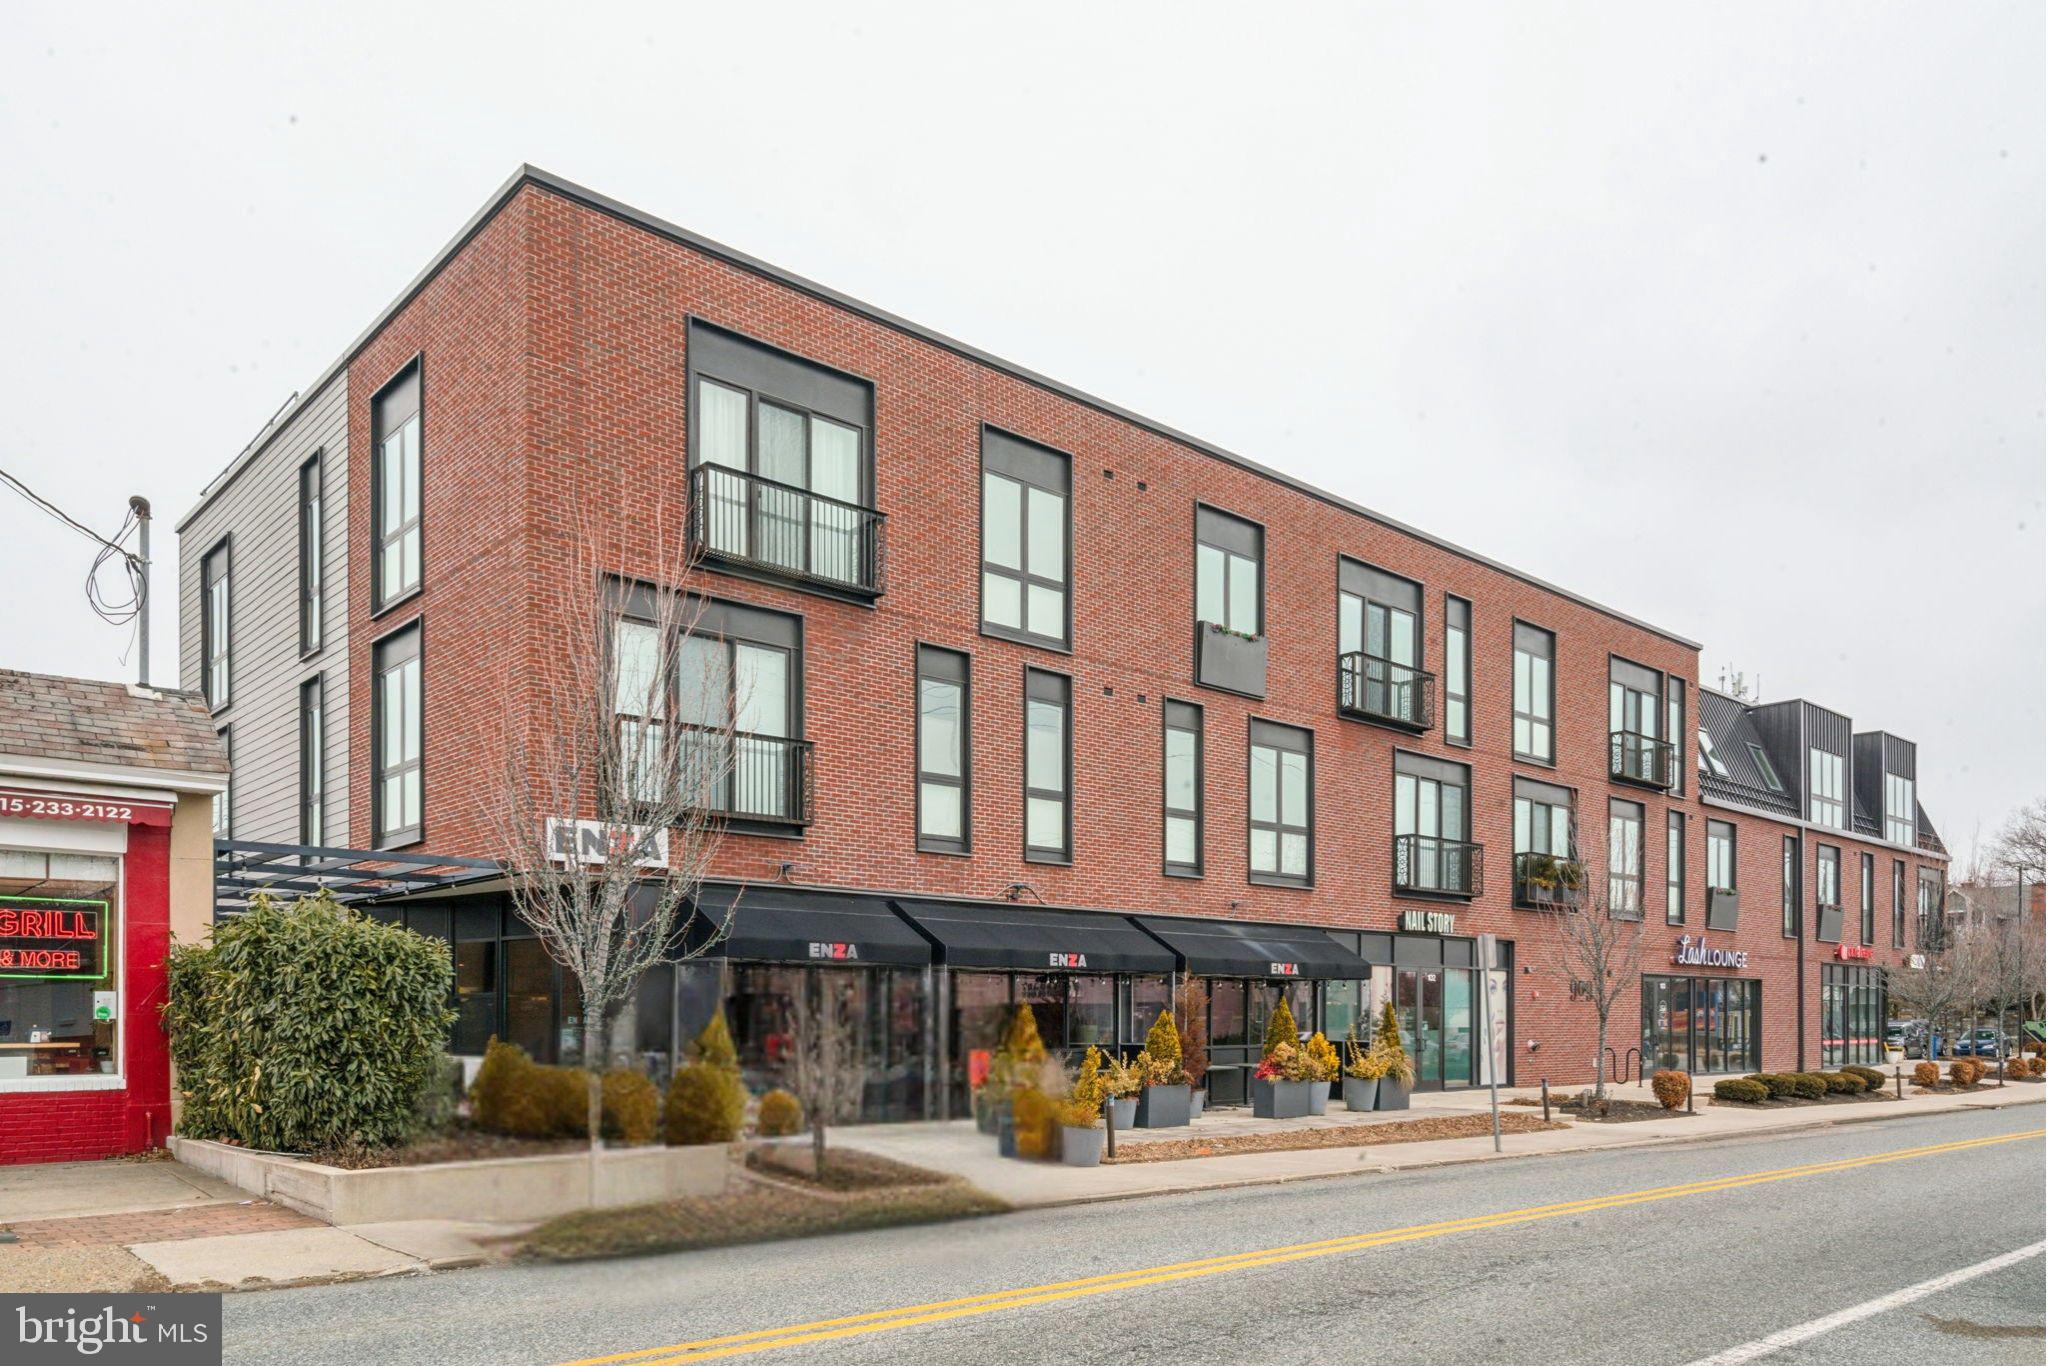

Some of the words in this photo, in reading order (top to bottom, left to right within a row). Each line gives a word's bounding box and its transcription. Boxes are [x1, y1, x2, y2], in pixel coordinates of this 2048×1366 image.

[0, 910, 96, 939] GRILL
[1405, 910, 1426, 931] NAIL
[1427, 911, 1456, 934] STORY
[808, 942, 858, 959] ENZA
[1678, 934, 1707, 965] Lash
[1708, 949, 1749, 968] LOUNGE
[20, 951, 80, 968] MORE
[1050, 952, 1087, 968] ENZA
[1271, 962, 1299, 975] ENZA
